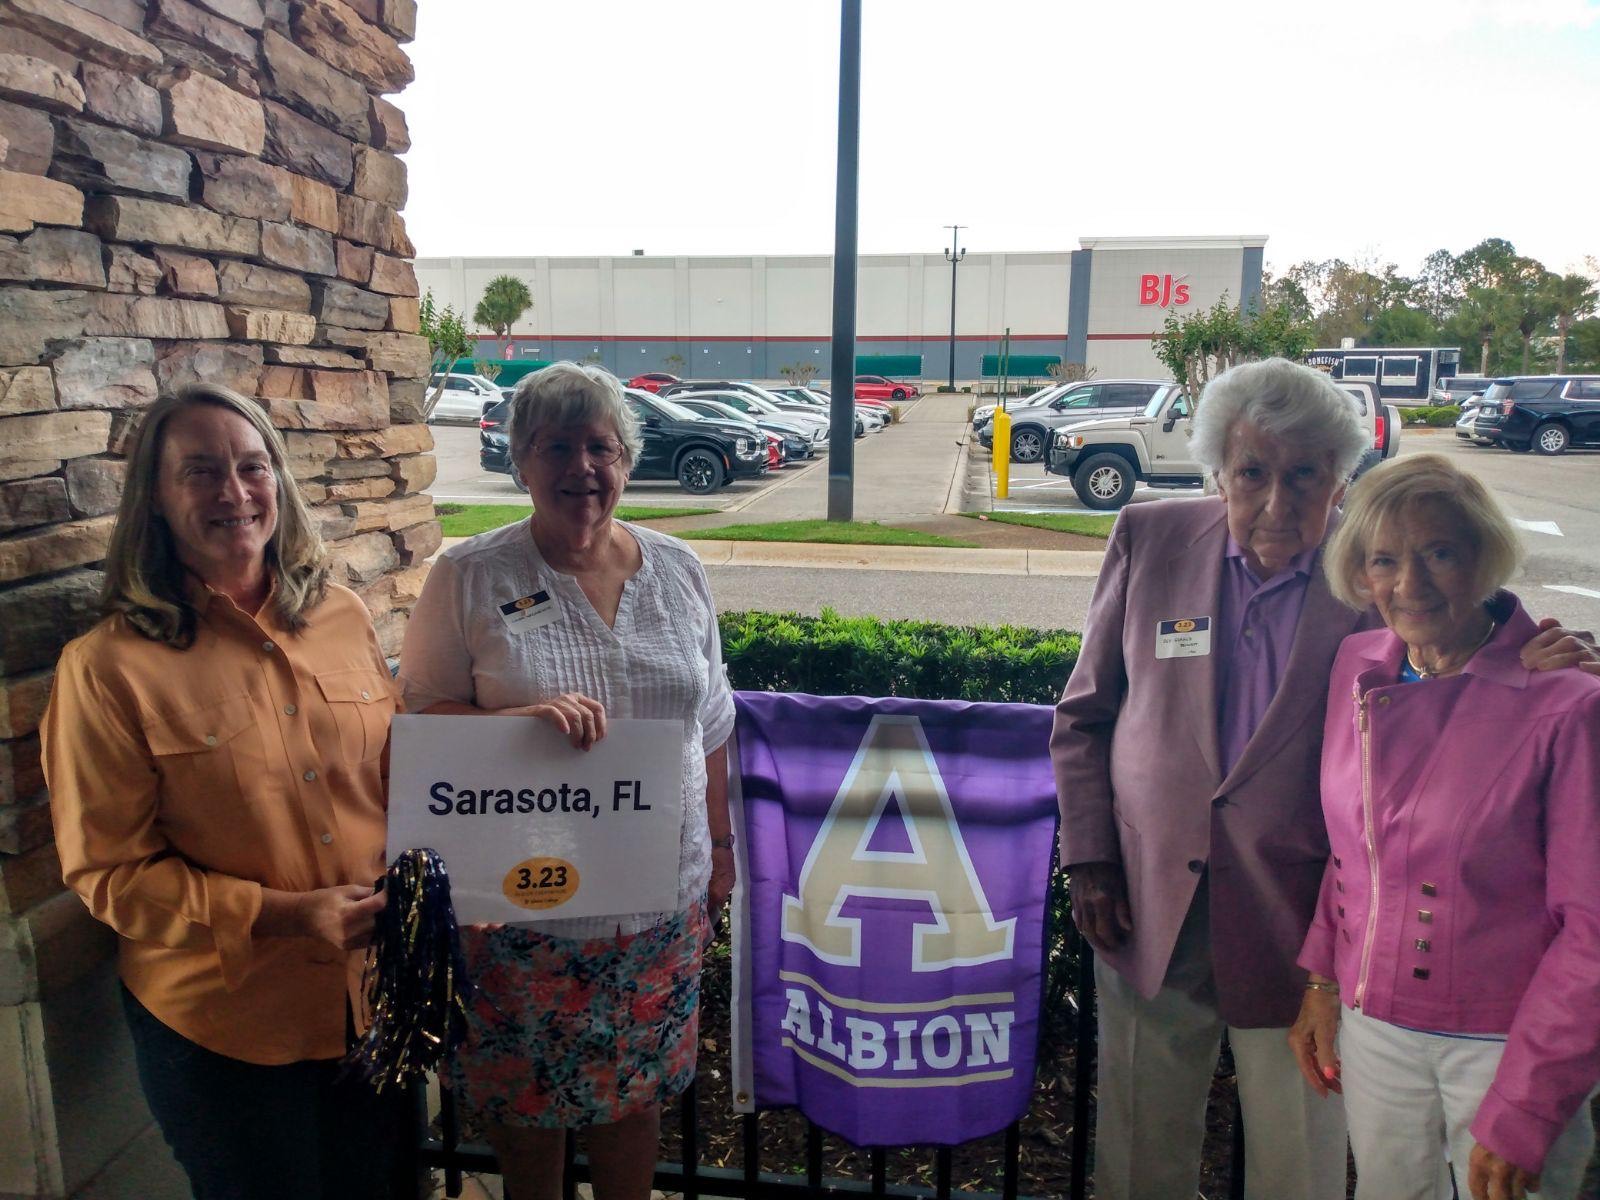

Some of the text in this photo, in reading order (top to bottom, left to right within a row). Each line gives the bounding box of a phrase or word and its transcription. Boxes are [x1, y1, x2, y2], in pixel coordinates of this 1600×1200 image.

[1140, 274, 1190, 308] BJ's
[428, 780, 651, 818] Sarasota, FL
[781, 714, 1018, 972] A
[516, 866, 567, 889] 3.23
[781, 989, 1016, 1071] ALBION
